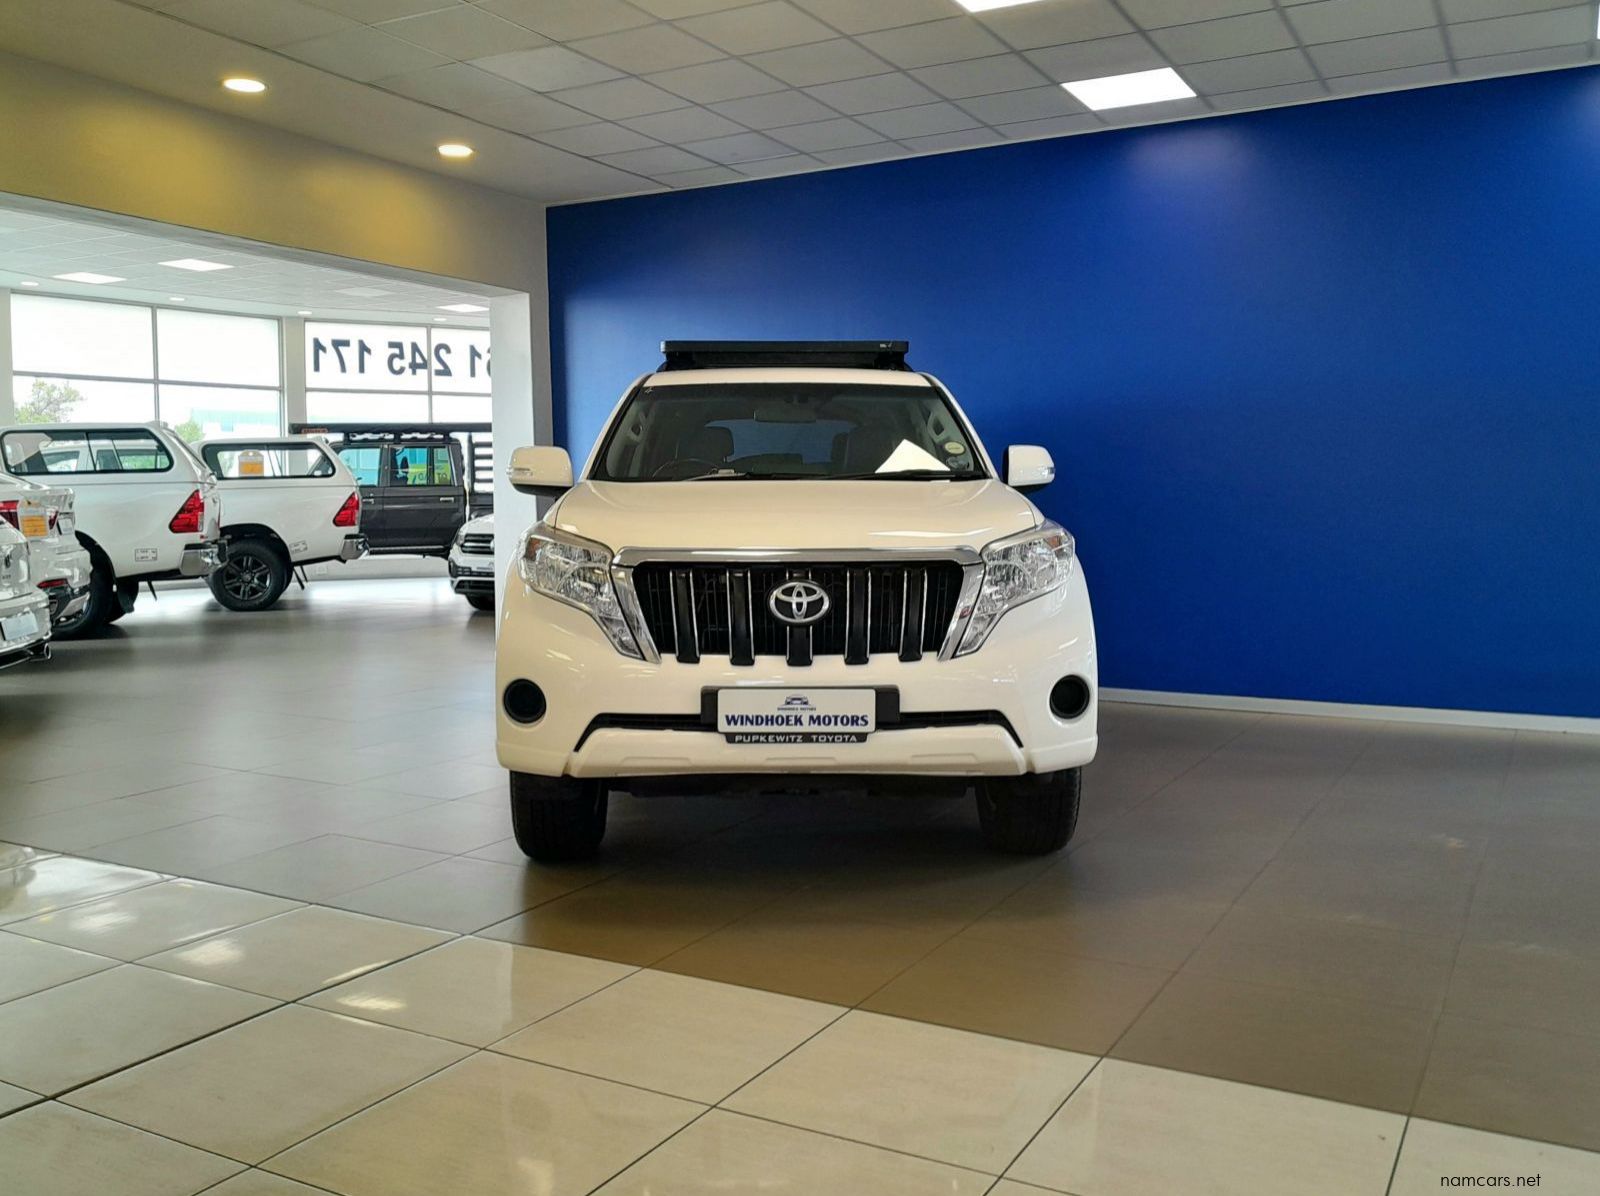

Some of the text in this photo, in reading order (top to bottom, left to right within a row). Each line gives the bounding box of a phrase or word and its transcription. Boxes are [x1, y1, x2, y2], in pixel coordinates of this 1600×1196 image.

[725, 714, 869, 727] WINDHOEK MOTORS
[735, 734, 857, 743] PUPKEWITZ TOYOTA
